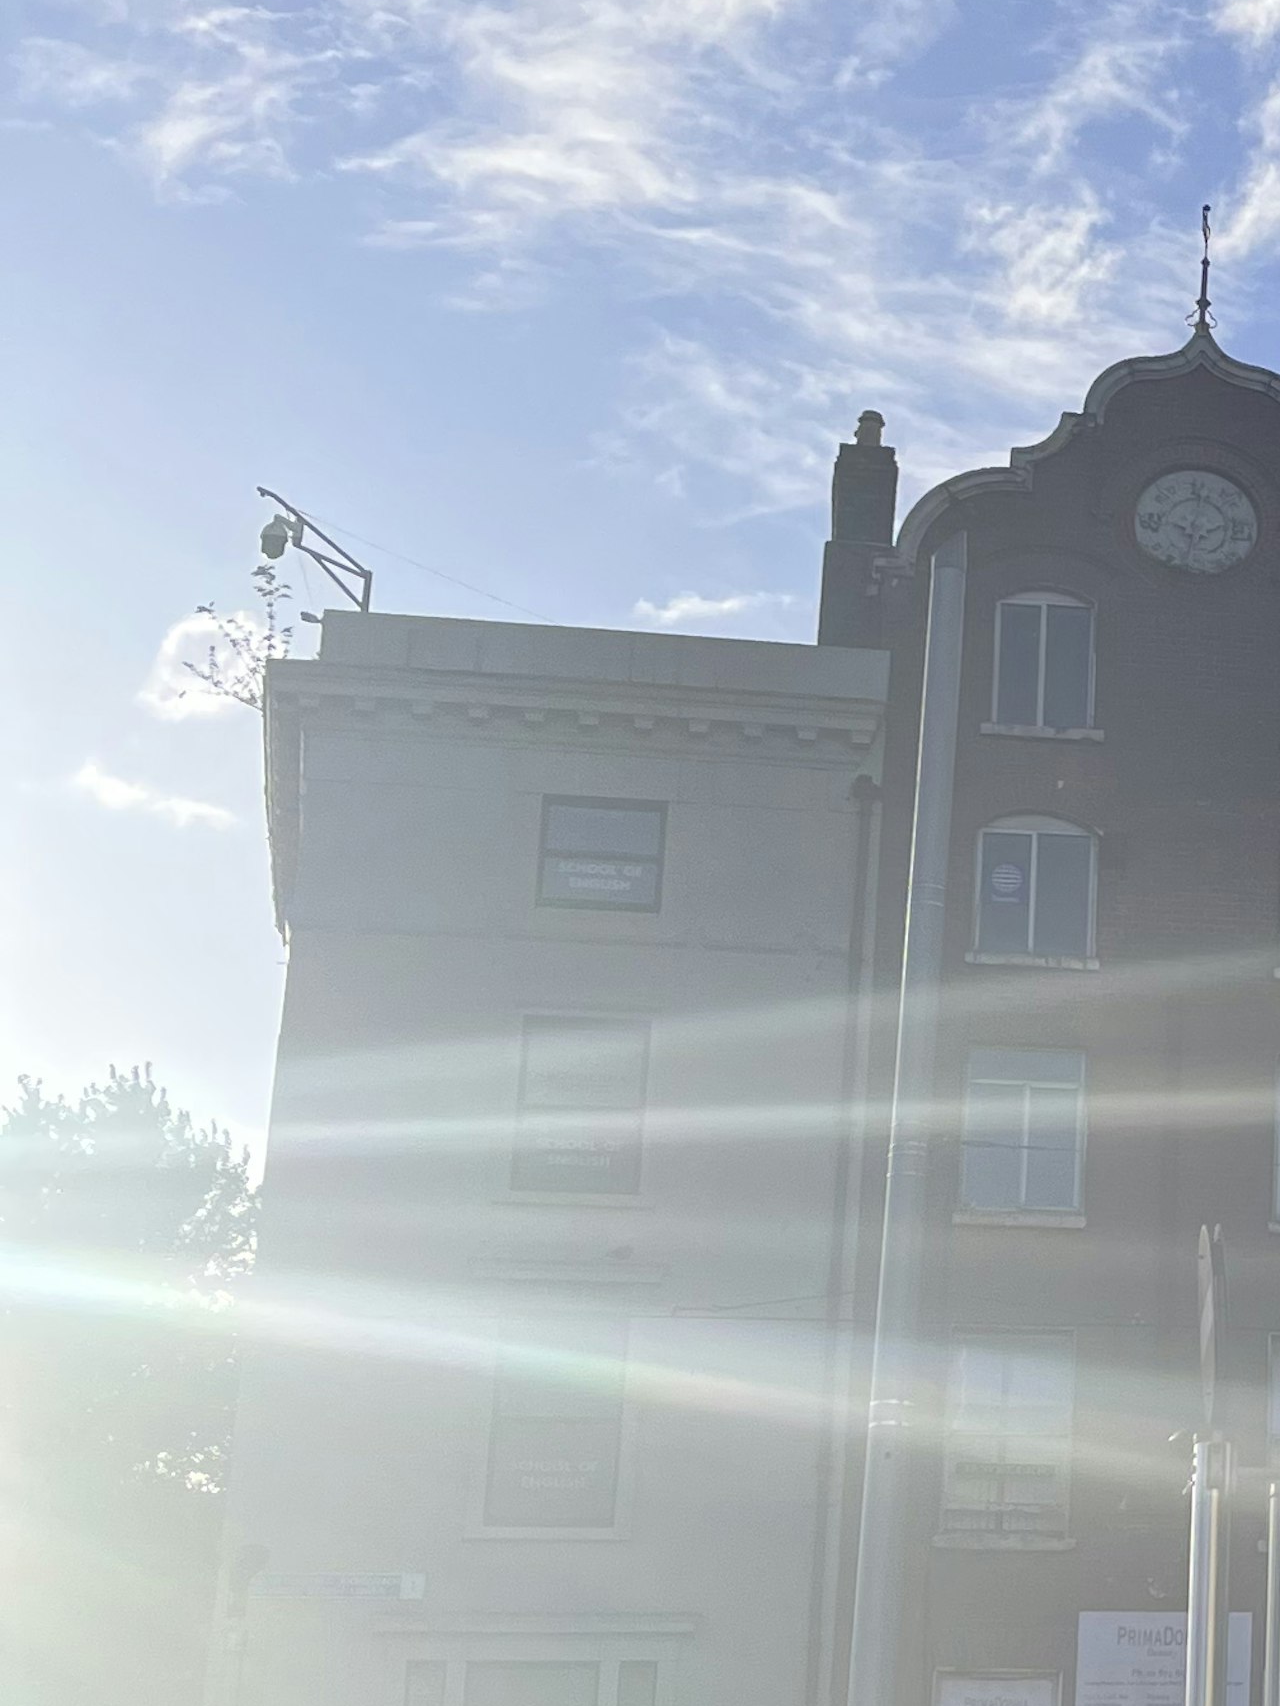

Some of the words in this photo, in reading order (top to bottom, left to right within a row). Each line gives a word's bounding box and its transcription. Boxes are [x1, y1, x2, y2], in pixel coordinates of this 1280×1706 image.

[558, 861, 617, 875] SCHOOL
[568, 877, 631, 890] ENGLISH
[1117, 1625, 1184, 1647] PRIMADO
